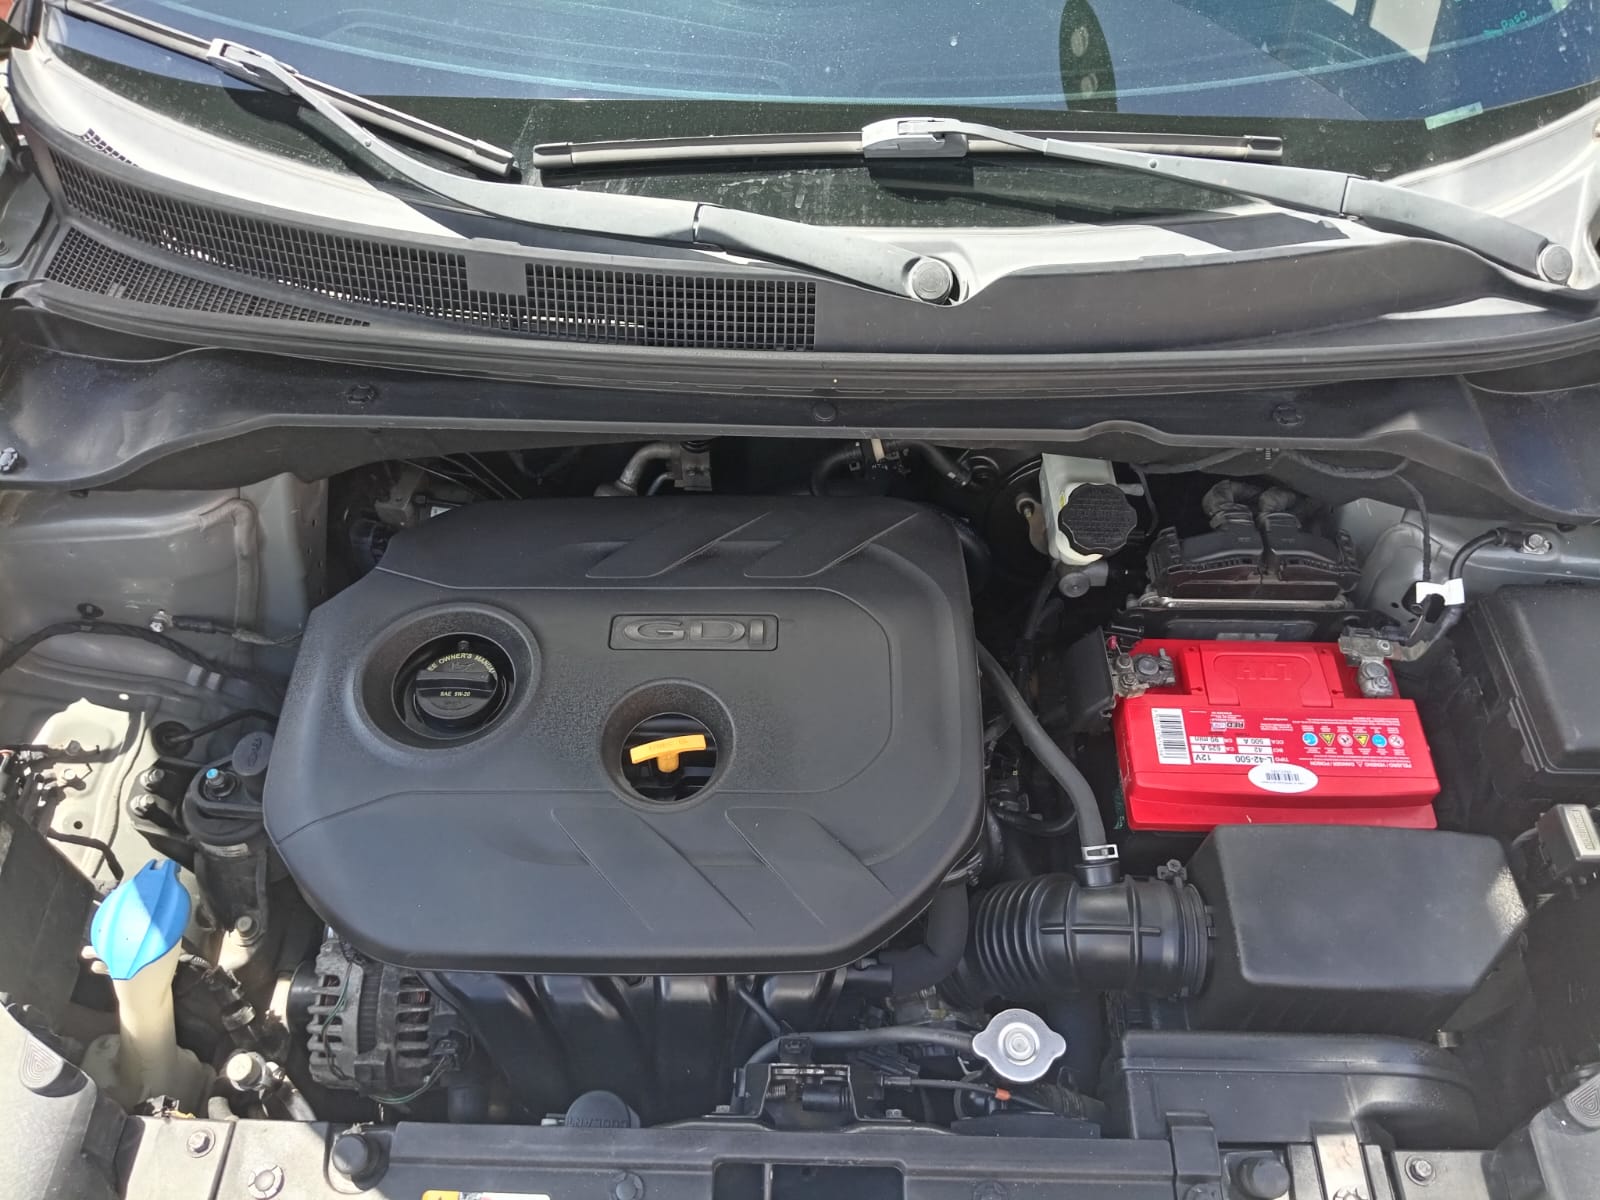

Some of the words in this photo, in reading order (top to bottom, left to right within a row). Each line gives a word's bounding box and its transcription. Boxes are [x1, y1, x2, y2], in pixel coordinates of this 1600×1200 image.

[624, 618, 766, 645] GDI
[439, 652, 472, 664] OWNER'S
[1235, 755, 1273, 763] L-42-500
